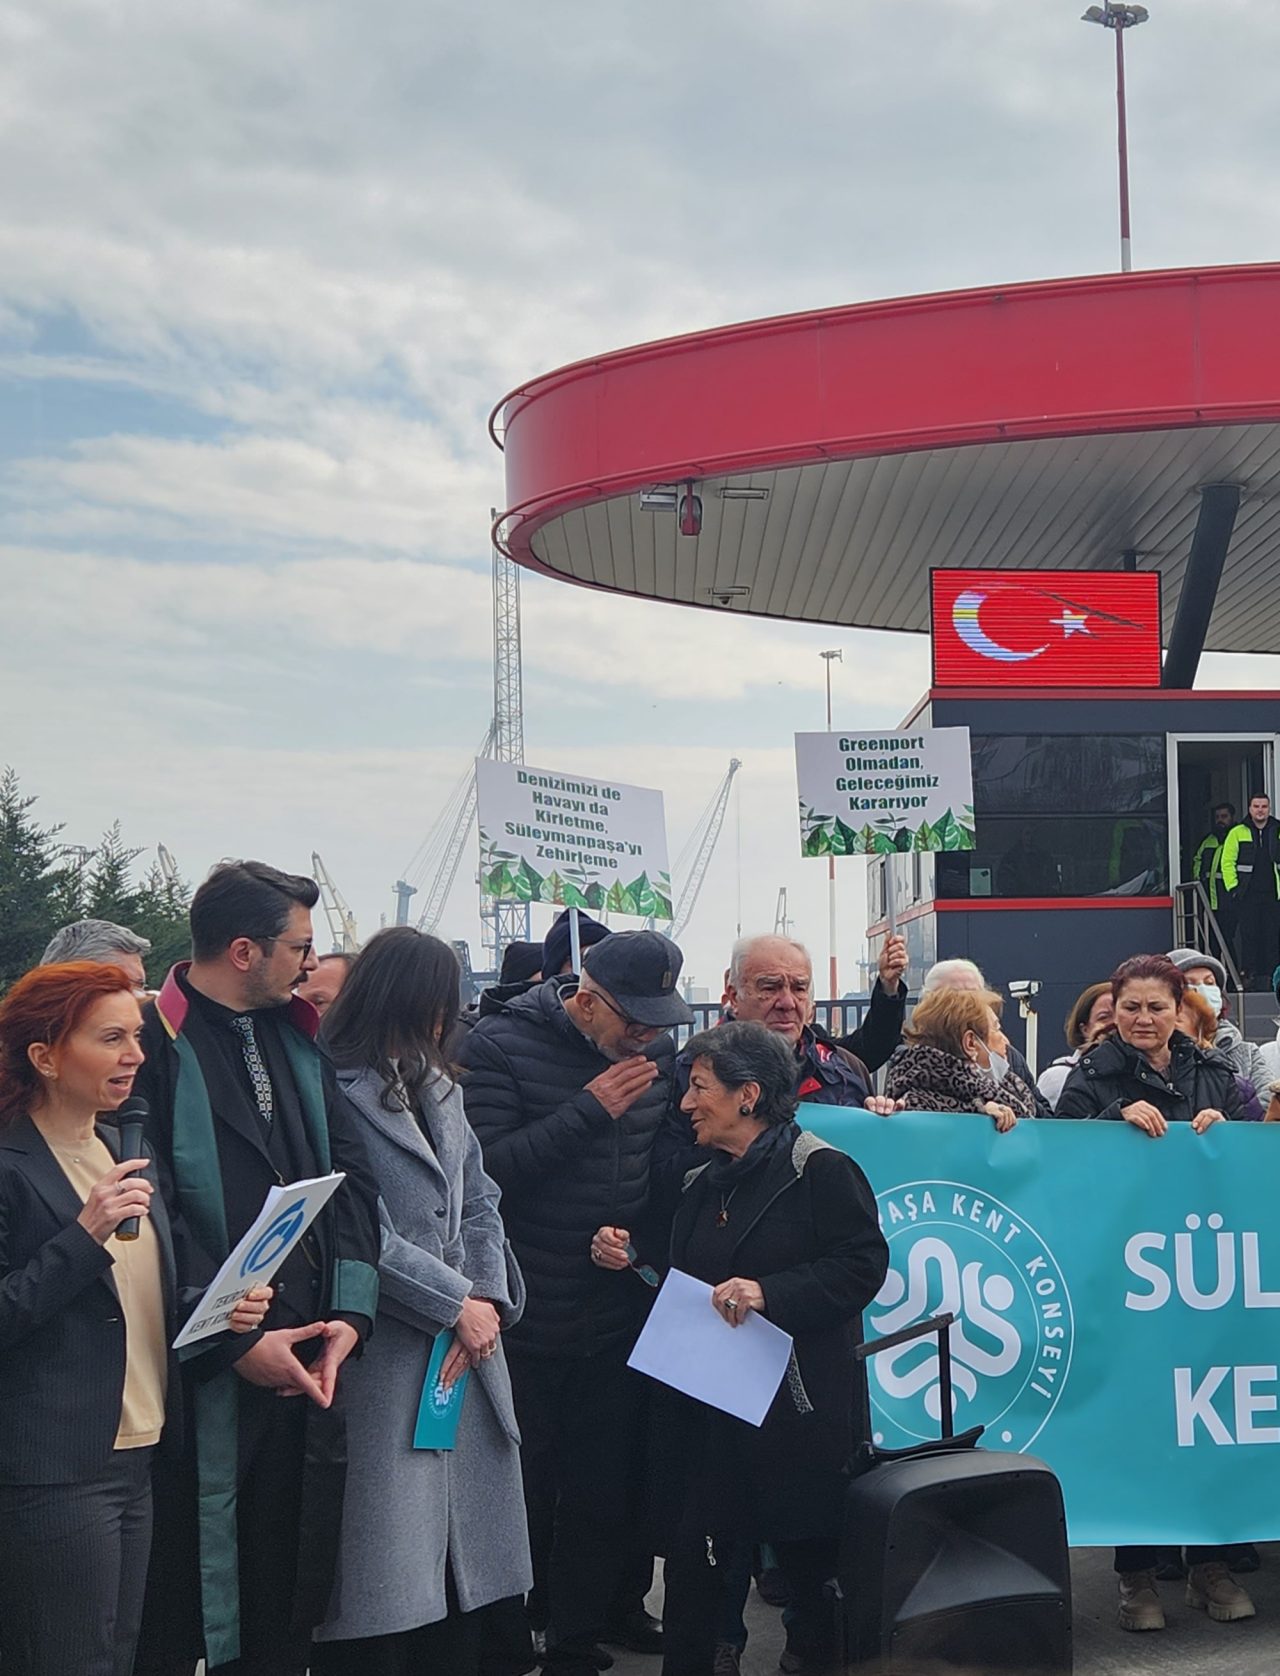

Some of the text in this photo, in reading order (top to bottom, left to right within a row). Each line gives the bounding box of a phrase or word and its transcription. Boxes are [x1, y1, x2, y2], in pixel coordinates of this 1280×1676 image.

[839, 736, 925, 753] Greenport
[845, 756, 924, 772] Olmadan,
[516, 770, 621, 801] Denizimizi de
[835, 774, 939, 791] Geleceğimiz
[532, 791, 609, 816] Havayı da
[849, 796, 928, 810] Kararıyor
[535, 809, 609, 834] Kirletme,
[505, 821, 643, 856] Süleymanpaşa'yı
[536, 844, 619, 869] Zehirleme
[952, 1193, 1021, 1244] KENT
[1025, 1254, 1064, 1400] KONSEYİ
